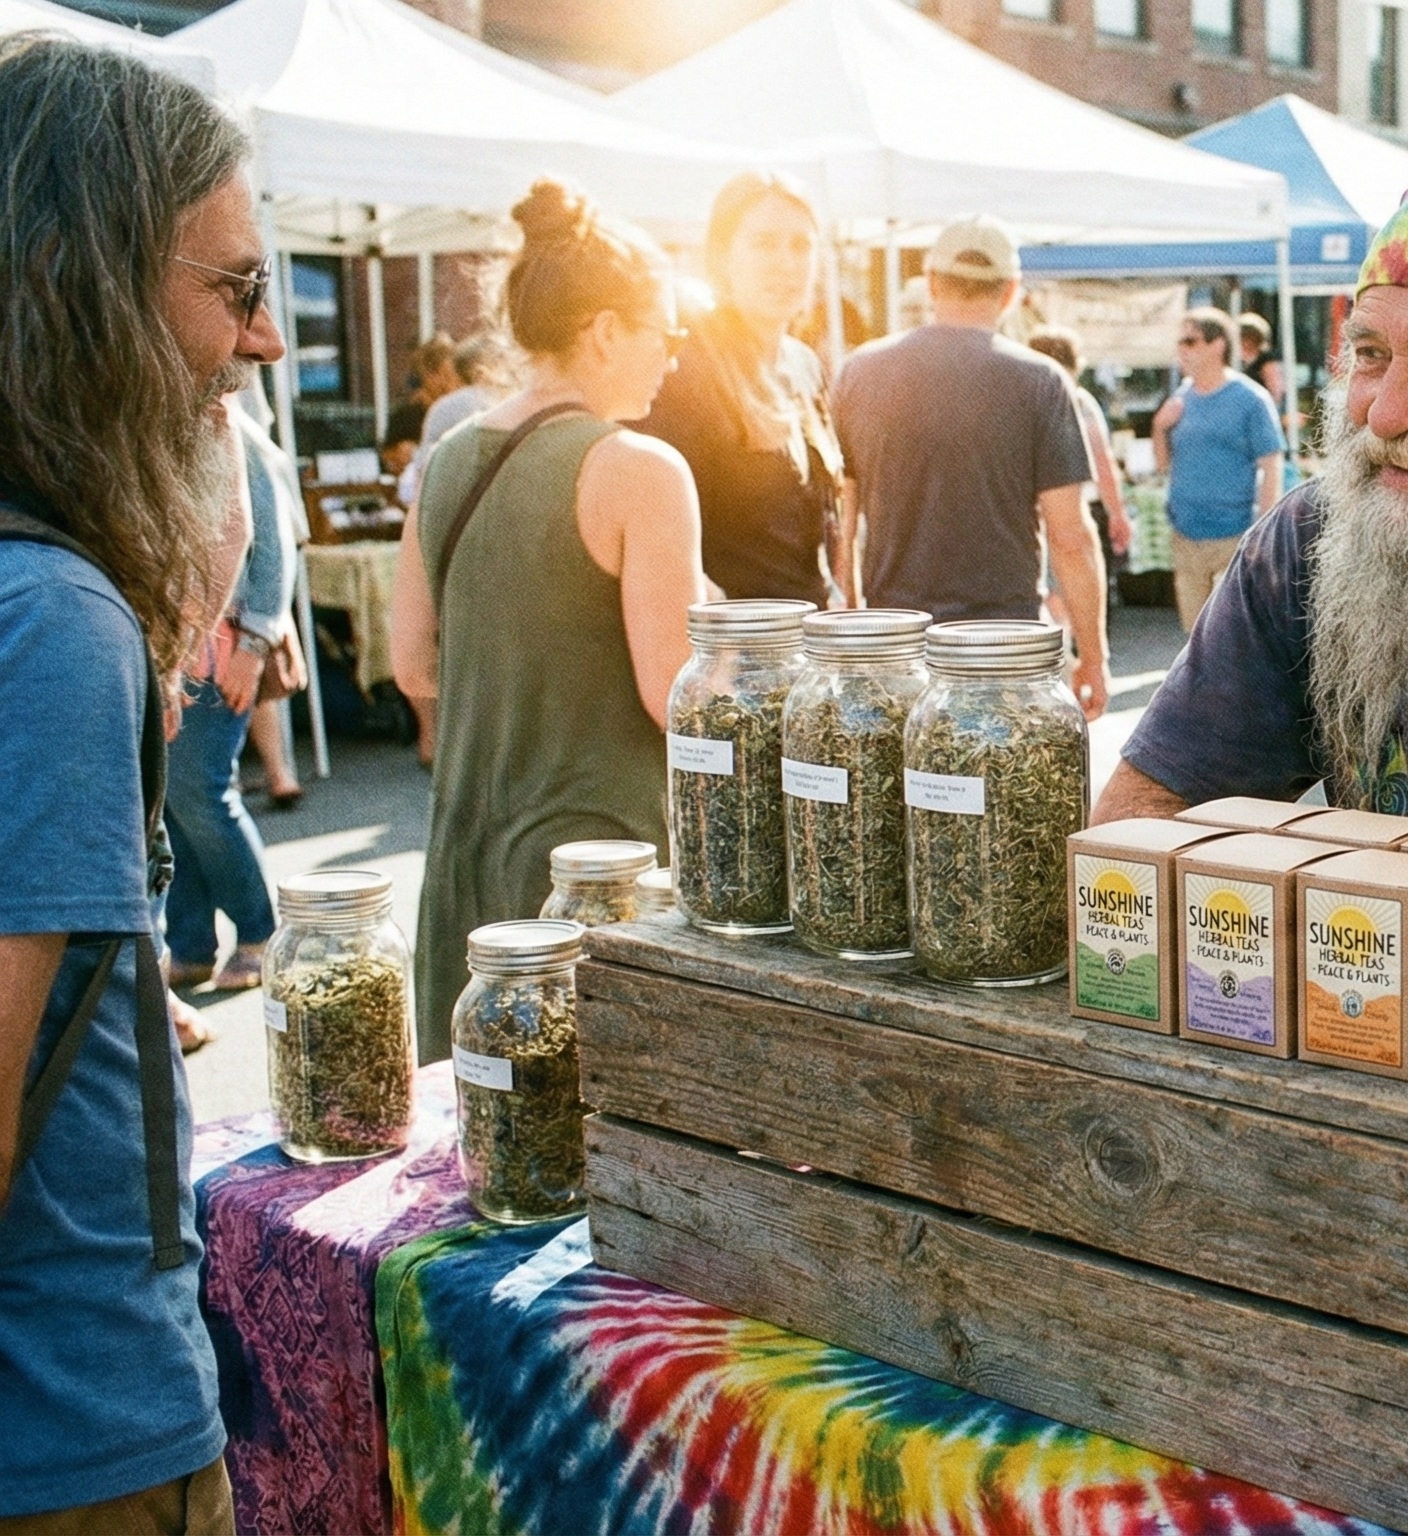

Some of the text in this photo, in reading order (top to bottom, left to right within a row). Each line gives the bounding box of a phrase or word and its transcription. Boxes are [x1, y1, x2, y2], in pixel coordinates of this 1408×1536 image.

[1079, 886, 1153, 917] SUNSHINE
[1189, 905, 1269, 938] SUNSHINE
[1309, 922, 1396, 956] SUNSHINE
